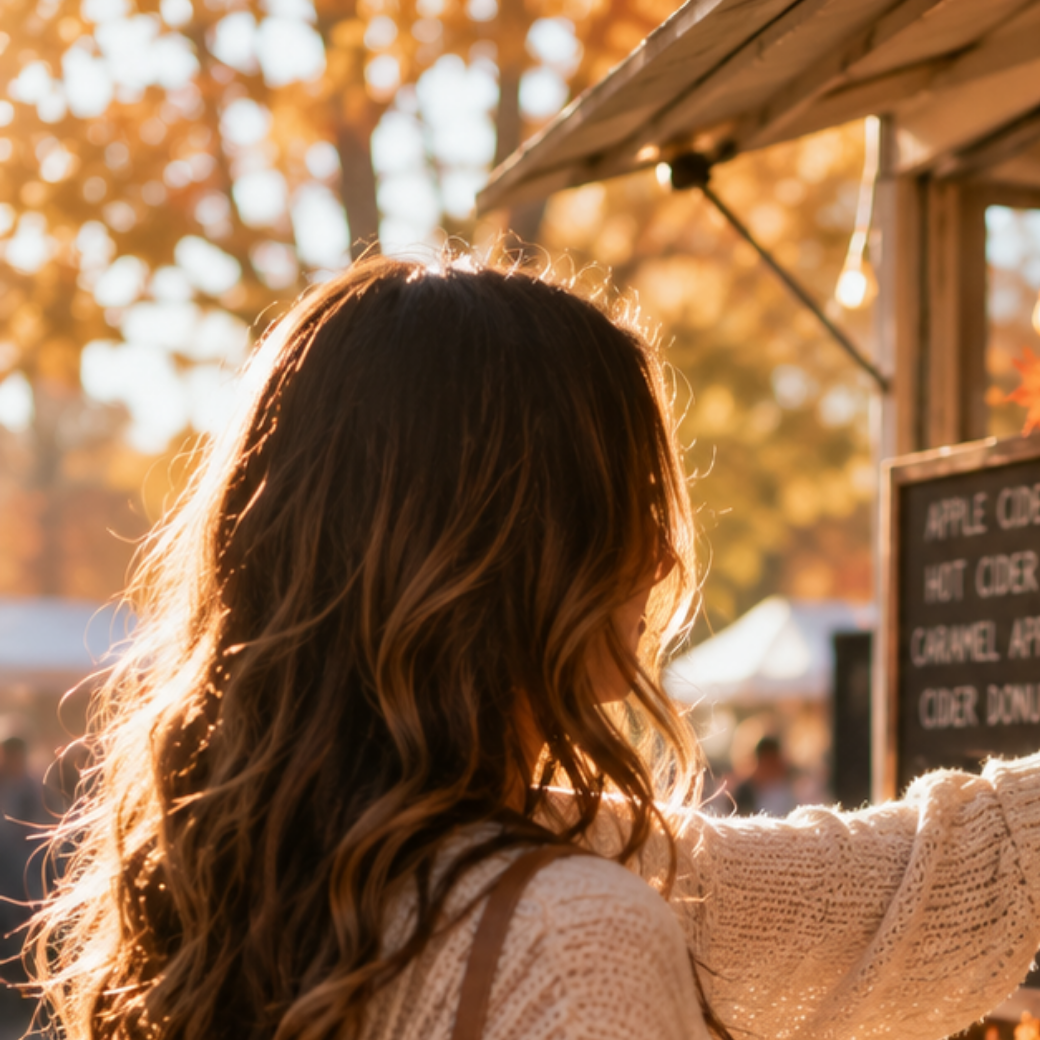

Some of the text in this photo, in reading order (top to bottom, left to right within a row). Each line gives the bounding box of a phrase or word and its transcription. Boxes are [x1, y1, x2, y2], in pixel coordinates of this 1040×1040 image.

[924, 492, 988, 541] APPLE
[924, 550, 1039, 604] HOT CIDER
[910, 620, 999, 667] CARAMEL
[918, 686, 978, 730] CIDER
